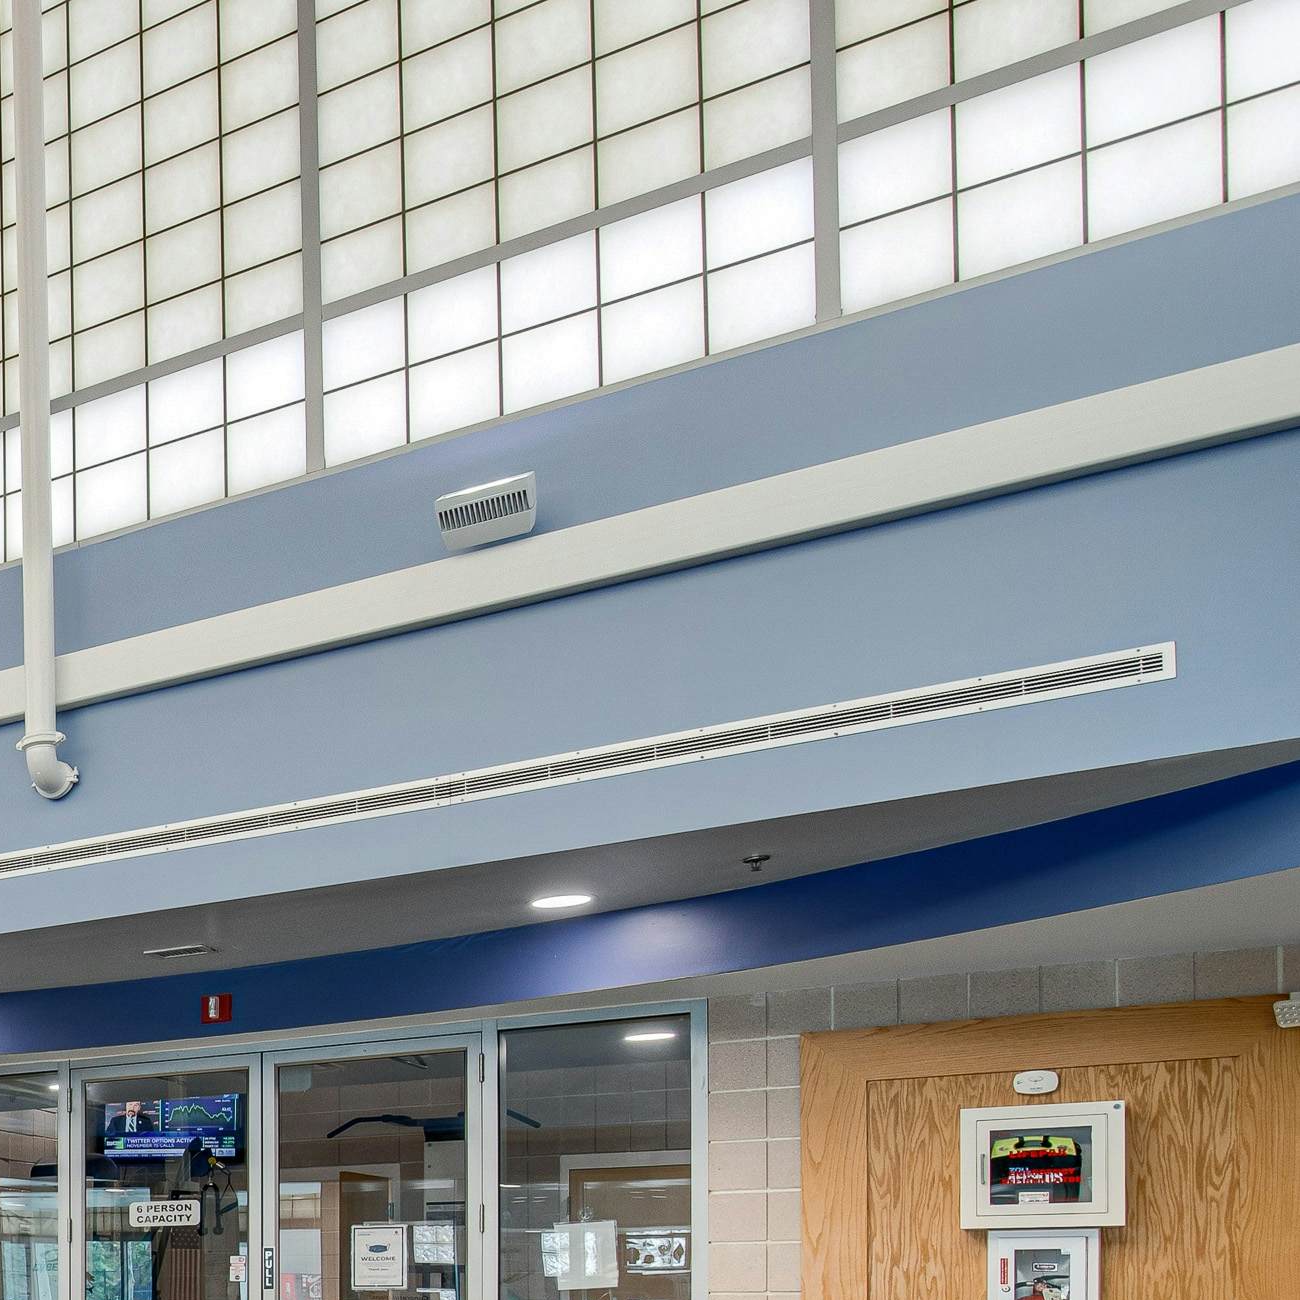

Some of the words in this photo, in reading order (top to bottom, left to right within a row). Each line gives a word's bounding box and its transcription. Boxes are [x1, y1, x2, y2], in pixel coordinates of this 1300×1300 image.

[136, 1206, 143, 1214] 6
[146, 1203, 192, 1213] PERSON
[136, 1214, 192, 1224] CAPACITY
[265, 1250, 273, 1287] PULL
